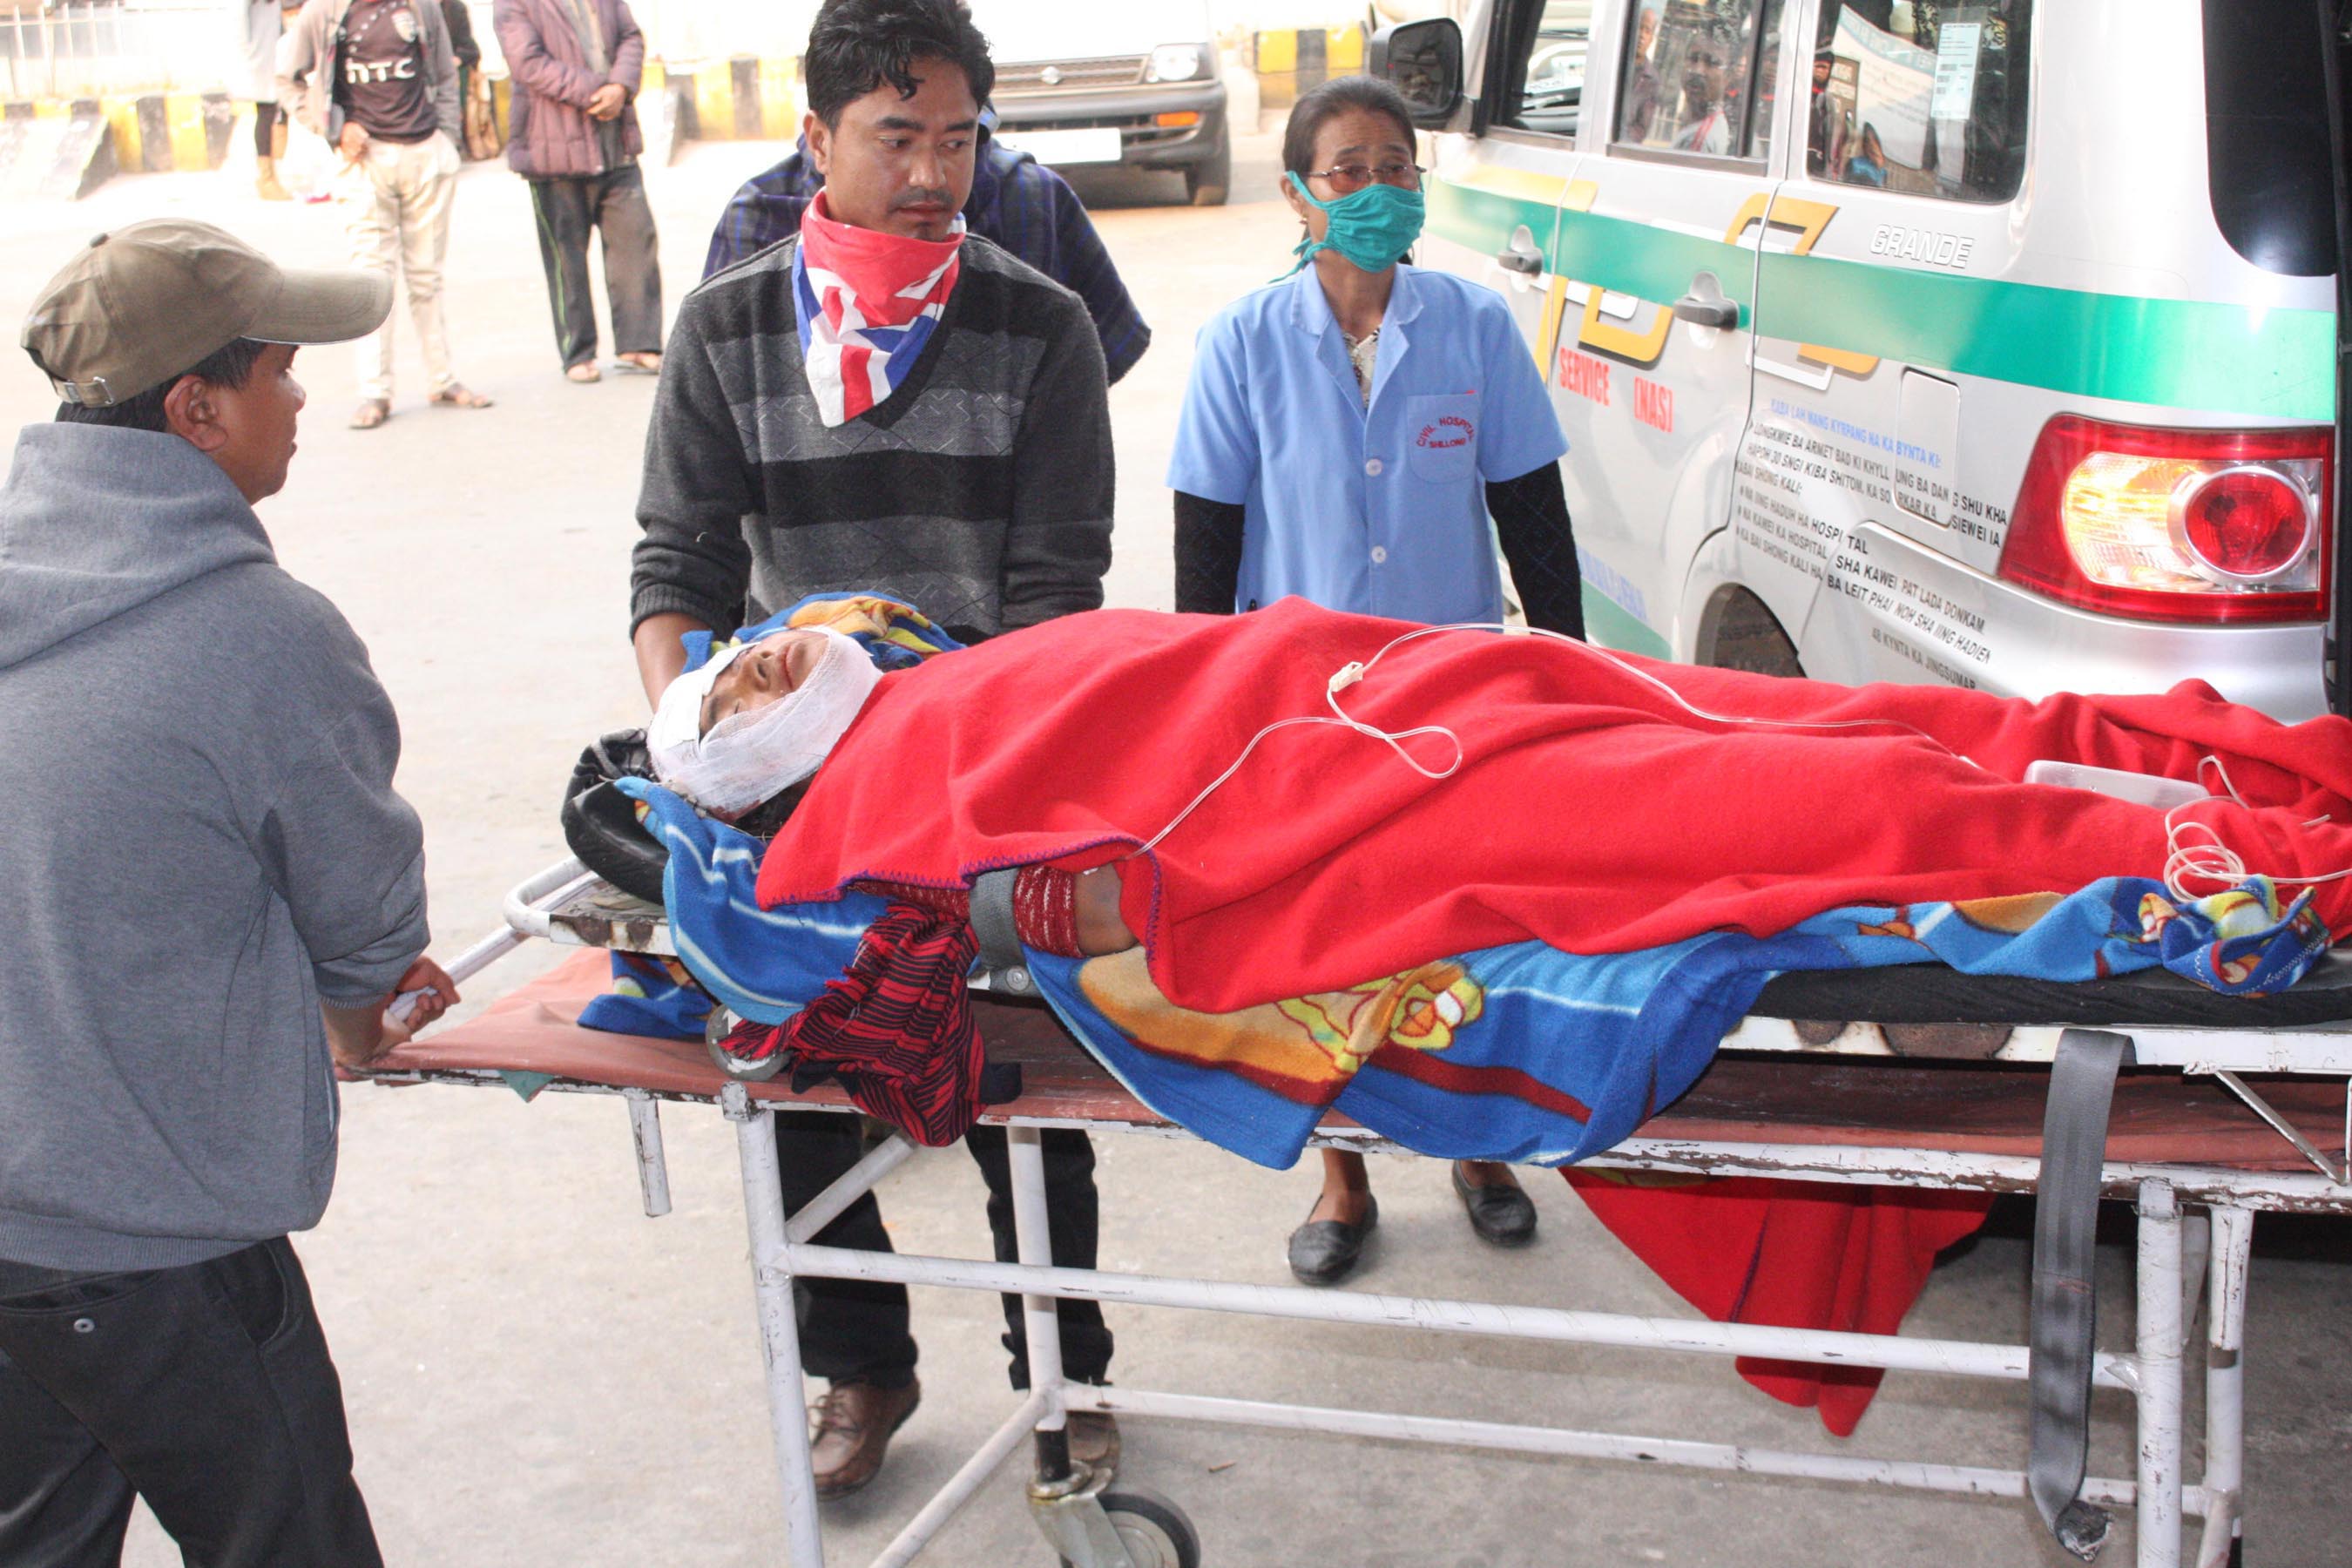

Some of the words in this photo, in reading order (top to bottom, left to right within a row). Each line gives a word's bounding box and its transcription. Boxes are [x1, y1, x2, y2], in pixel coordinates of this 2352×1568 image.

[1870, 223, 1975, 269] GRANDE
[1558, 346, 1610, 407] SERVICE
[1416, 424, 1436, 447] CIVIL
[1439, 416, 1475, 443] HOSPITAL
[1882, 435, 1894, 453] KA
[1896, 439, 1926, 464] BYNTA
[1781, 453, 1803, 472] SNGI
[1803, 462, 1827, 482] KIBA
[1866, 483, 1878, 500] KA
[1923, 502, 1936, 518] KA
[1990, 530, 2001, 548] IA
[1792, 434, 1803, 449] BA
[1804, 438, 1833, 460] ARMET
[1835, 448, 1851, 467] BAD
[1852, 455, 1862, 471] KI
[1916, 476, 1929, 495] BA
[1962, 496, 1984, 517] SHU
[1985, 504, 2007, 526] KHA
[1787, 528, 1827, 559] HOSPITAL
[1835, 555, 1860, 576] SHA
[1862, 564, 1897, 591] KAWEI
[1901, 579, 1919, 599] PAT
[1919, 588, 1942, 612] LADA
[1844, 581, 1869, 601] LEIT
[1868, 591, 1894, 612] PHAI
[1895, 602, 1916, 623] NOH
[1914, 613, 1936, 634] SHA
